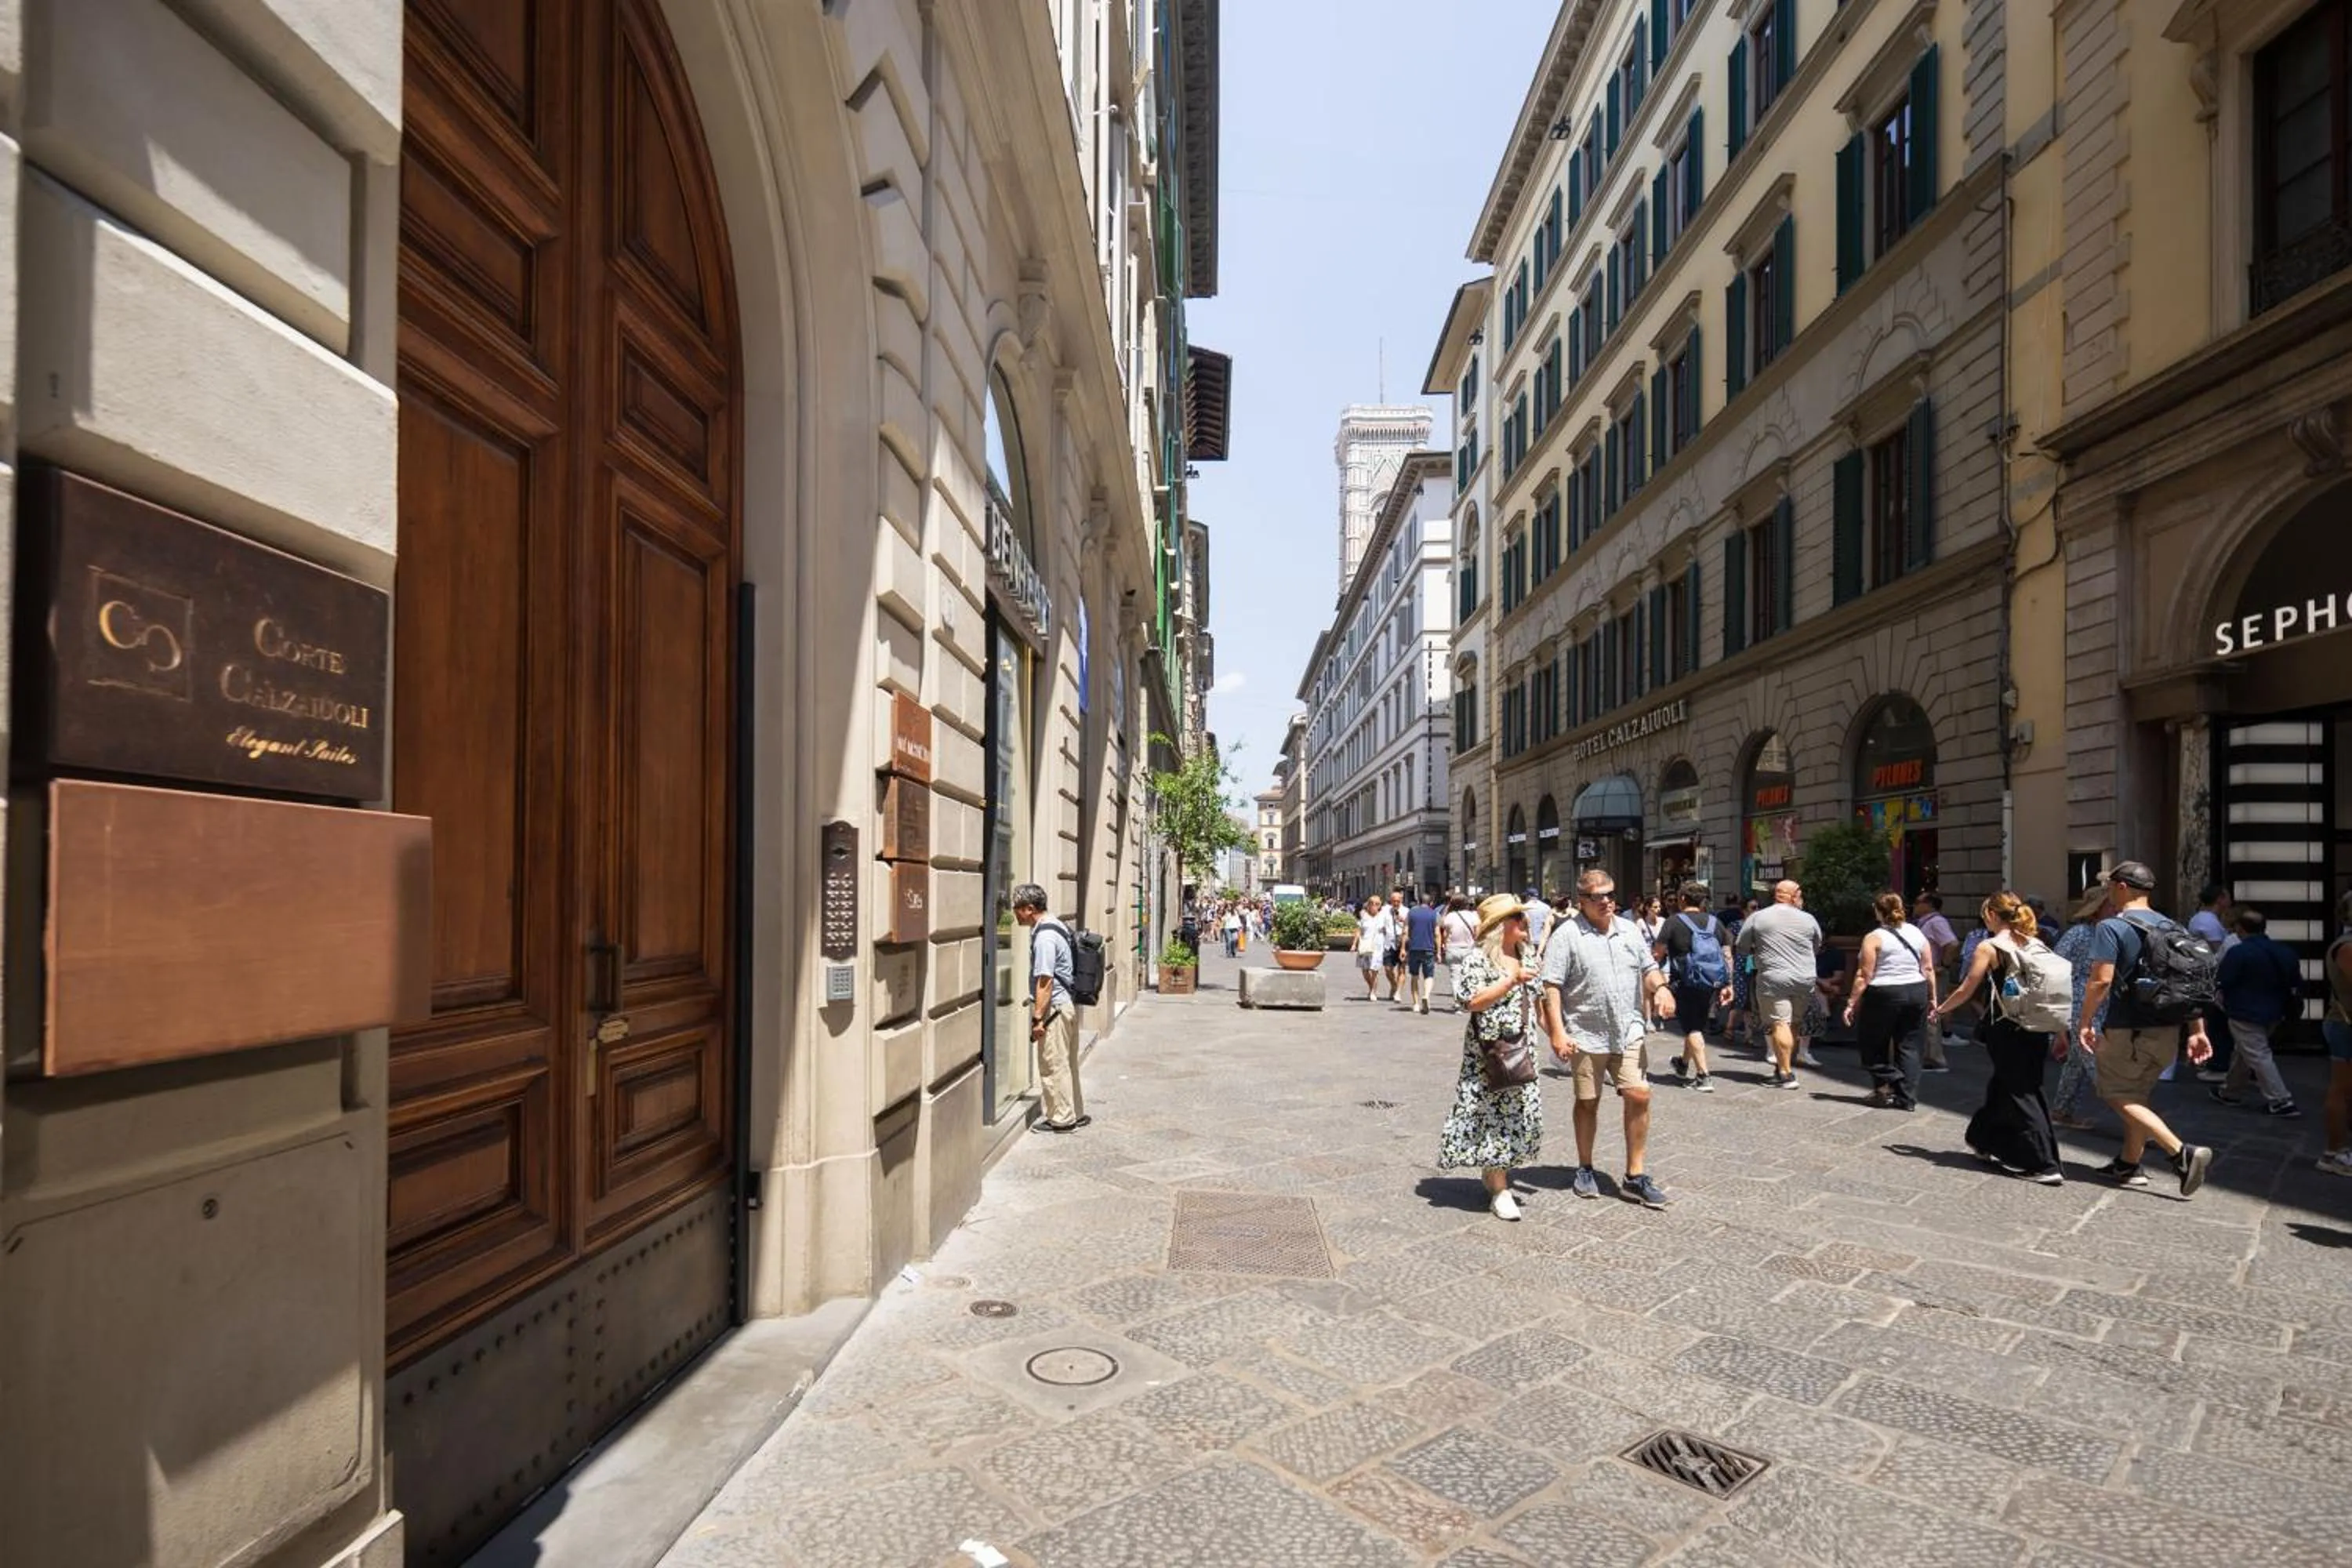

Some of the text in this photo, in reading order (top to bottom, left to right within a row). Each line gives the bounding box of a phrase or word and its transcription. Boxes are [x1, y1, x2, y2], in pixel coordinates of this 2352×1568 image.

[2215, 592, 2352, 655] SEPH
[220, 664, 370, 728] CALZAIUOLI
[226, 725, 307, 760] Elegant
[1573, 699, 1688, 762] HOTEL CALZAIUOLI
